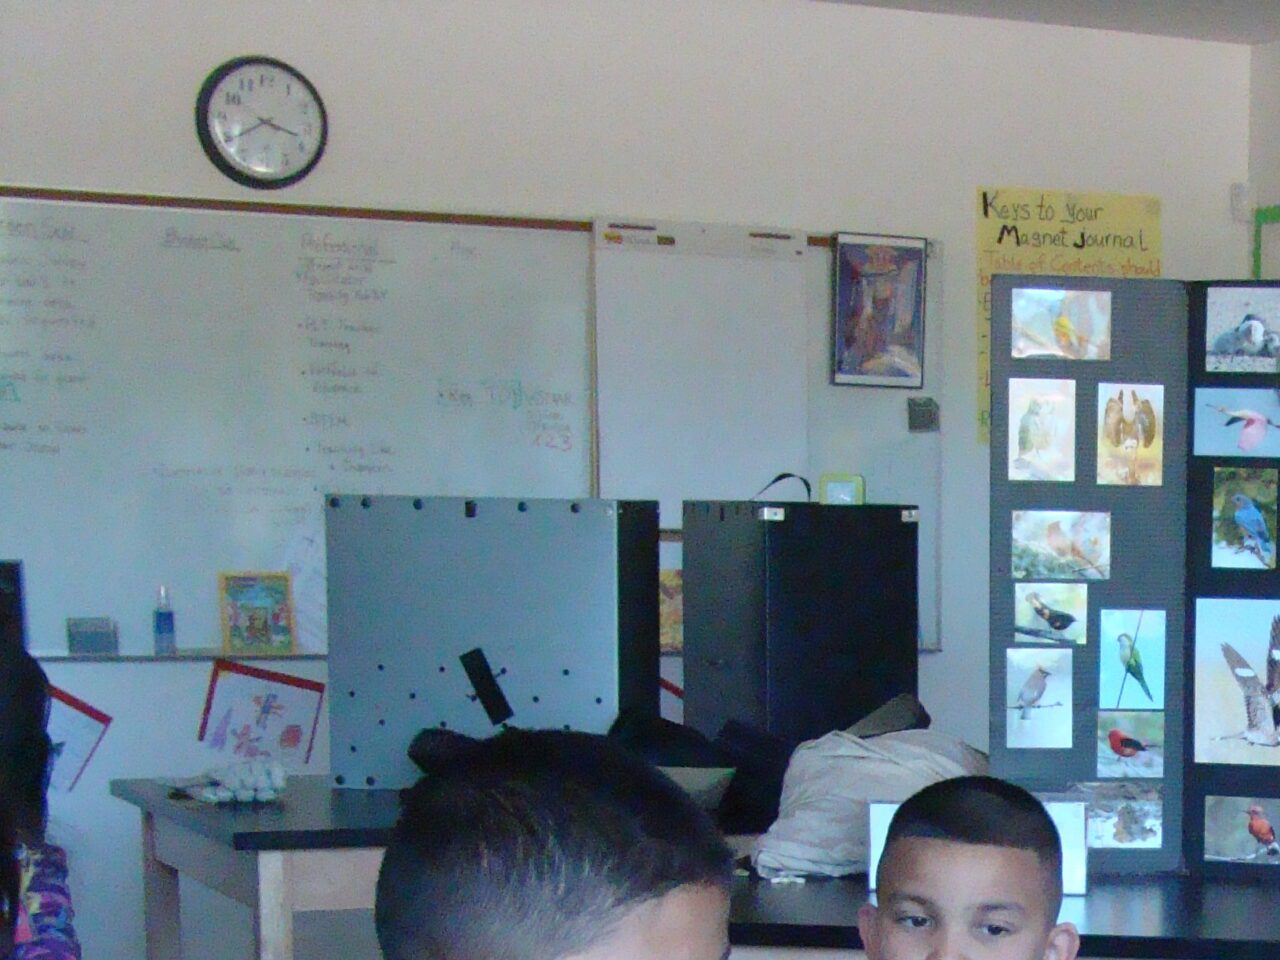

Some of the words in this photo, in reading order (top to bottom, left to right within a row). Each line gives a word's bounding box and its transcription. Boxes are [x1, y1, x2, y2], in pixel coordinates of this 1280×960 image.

[982, 190, 1031, 221] Keys
[1036, 194, 1055, 221] to
[1059, 201, 1104, 224] your
[996, 225, 1069, 248] Magnet
